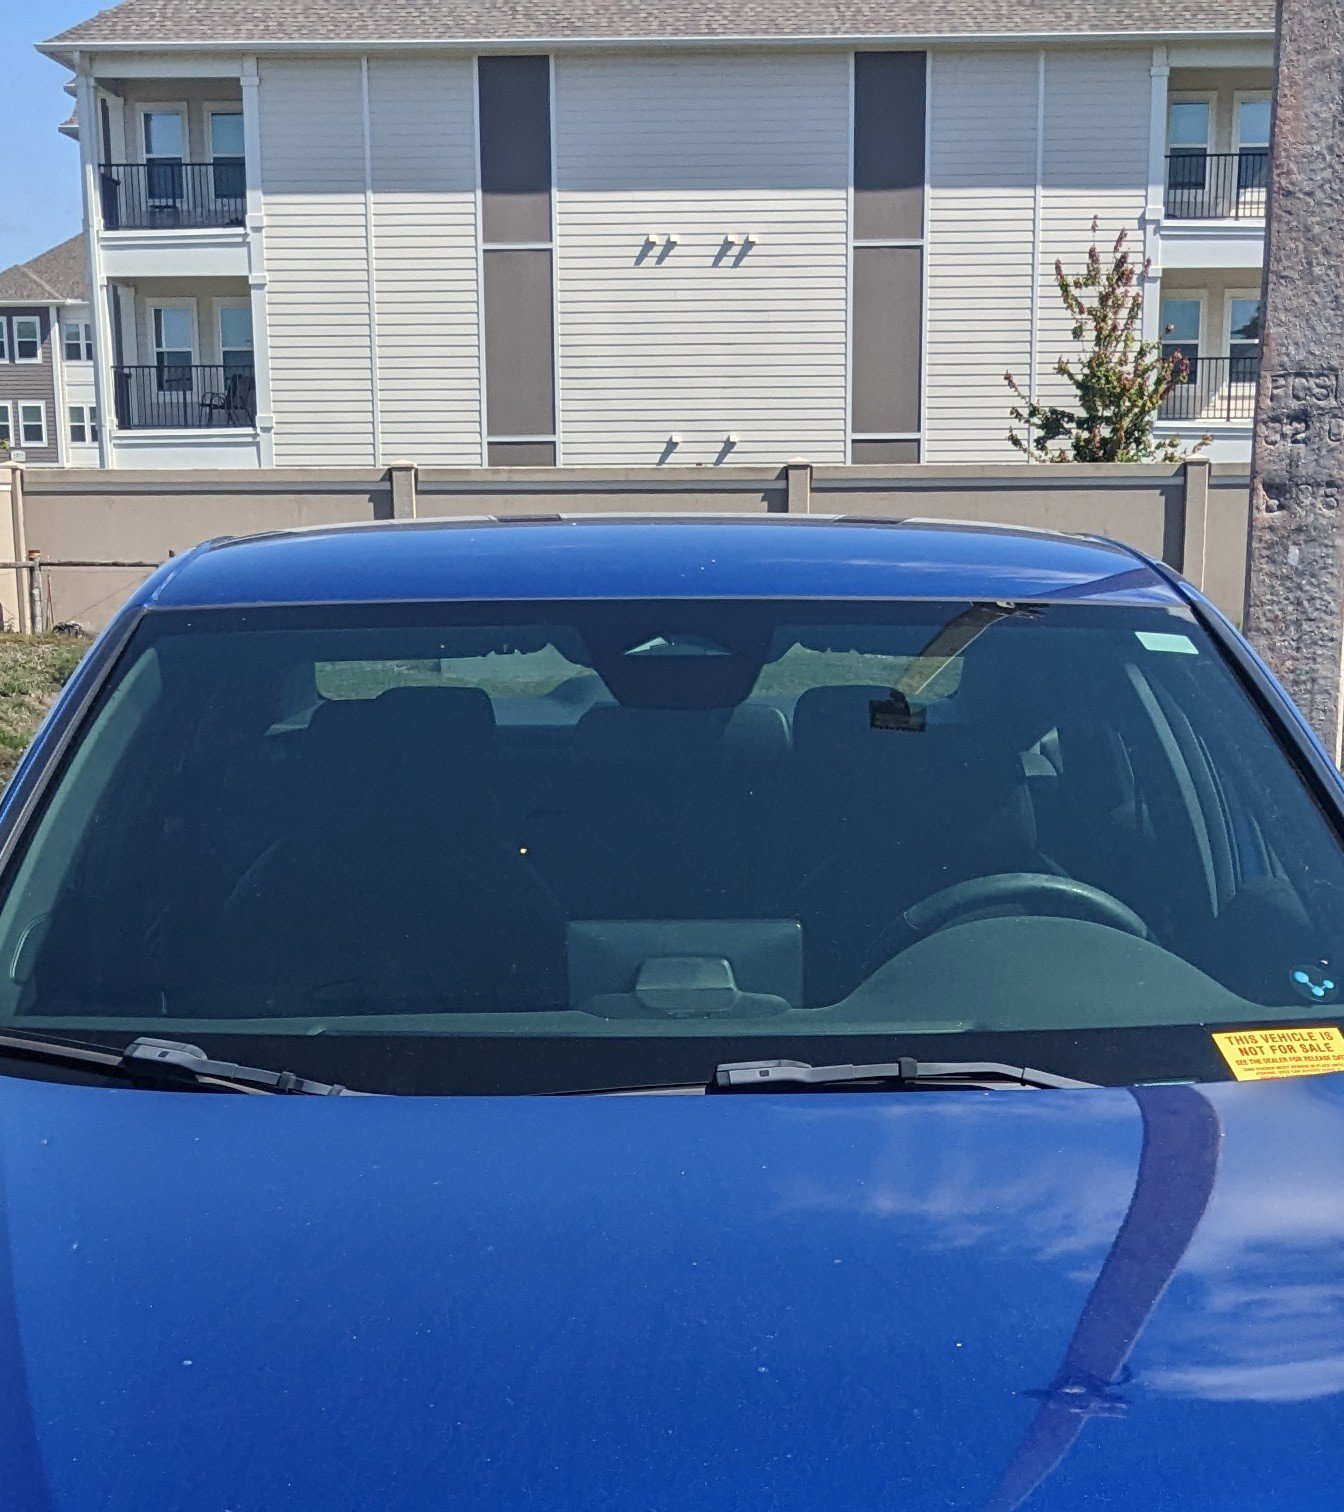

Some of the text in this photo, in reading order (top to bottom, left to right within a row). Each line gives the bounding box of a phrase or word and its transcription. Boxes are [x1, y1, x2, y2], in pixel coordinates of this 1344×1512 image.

[1224, 1031, 1334, 1046] THIS VEHICLE IS
[1238, 1042, 1334, 1057] NOT FOR SALE
